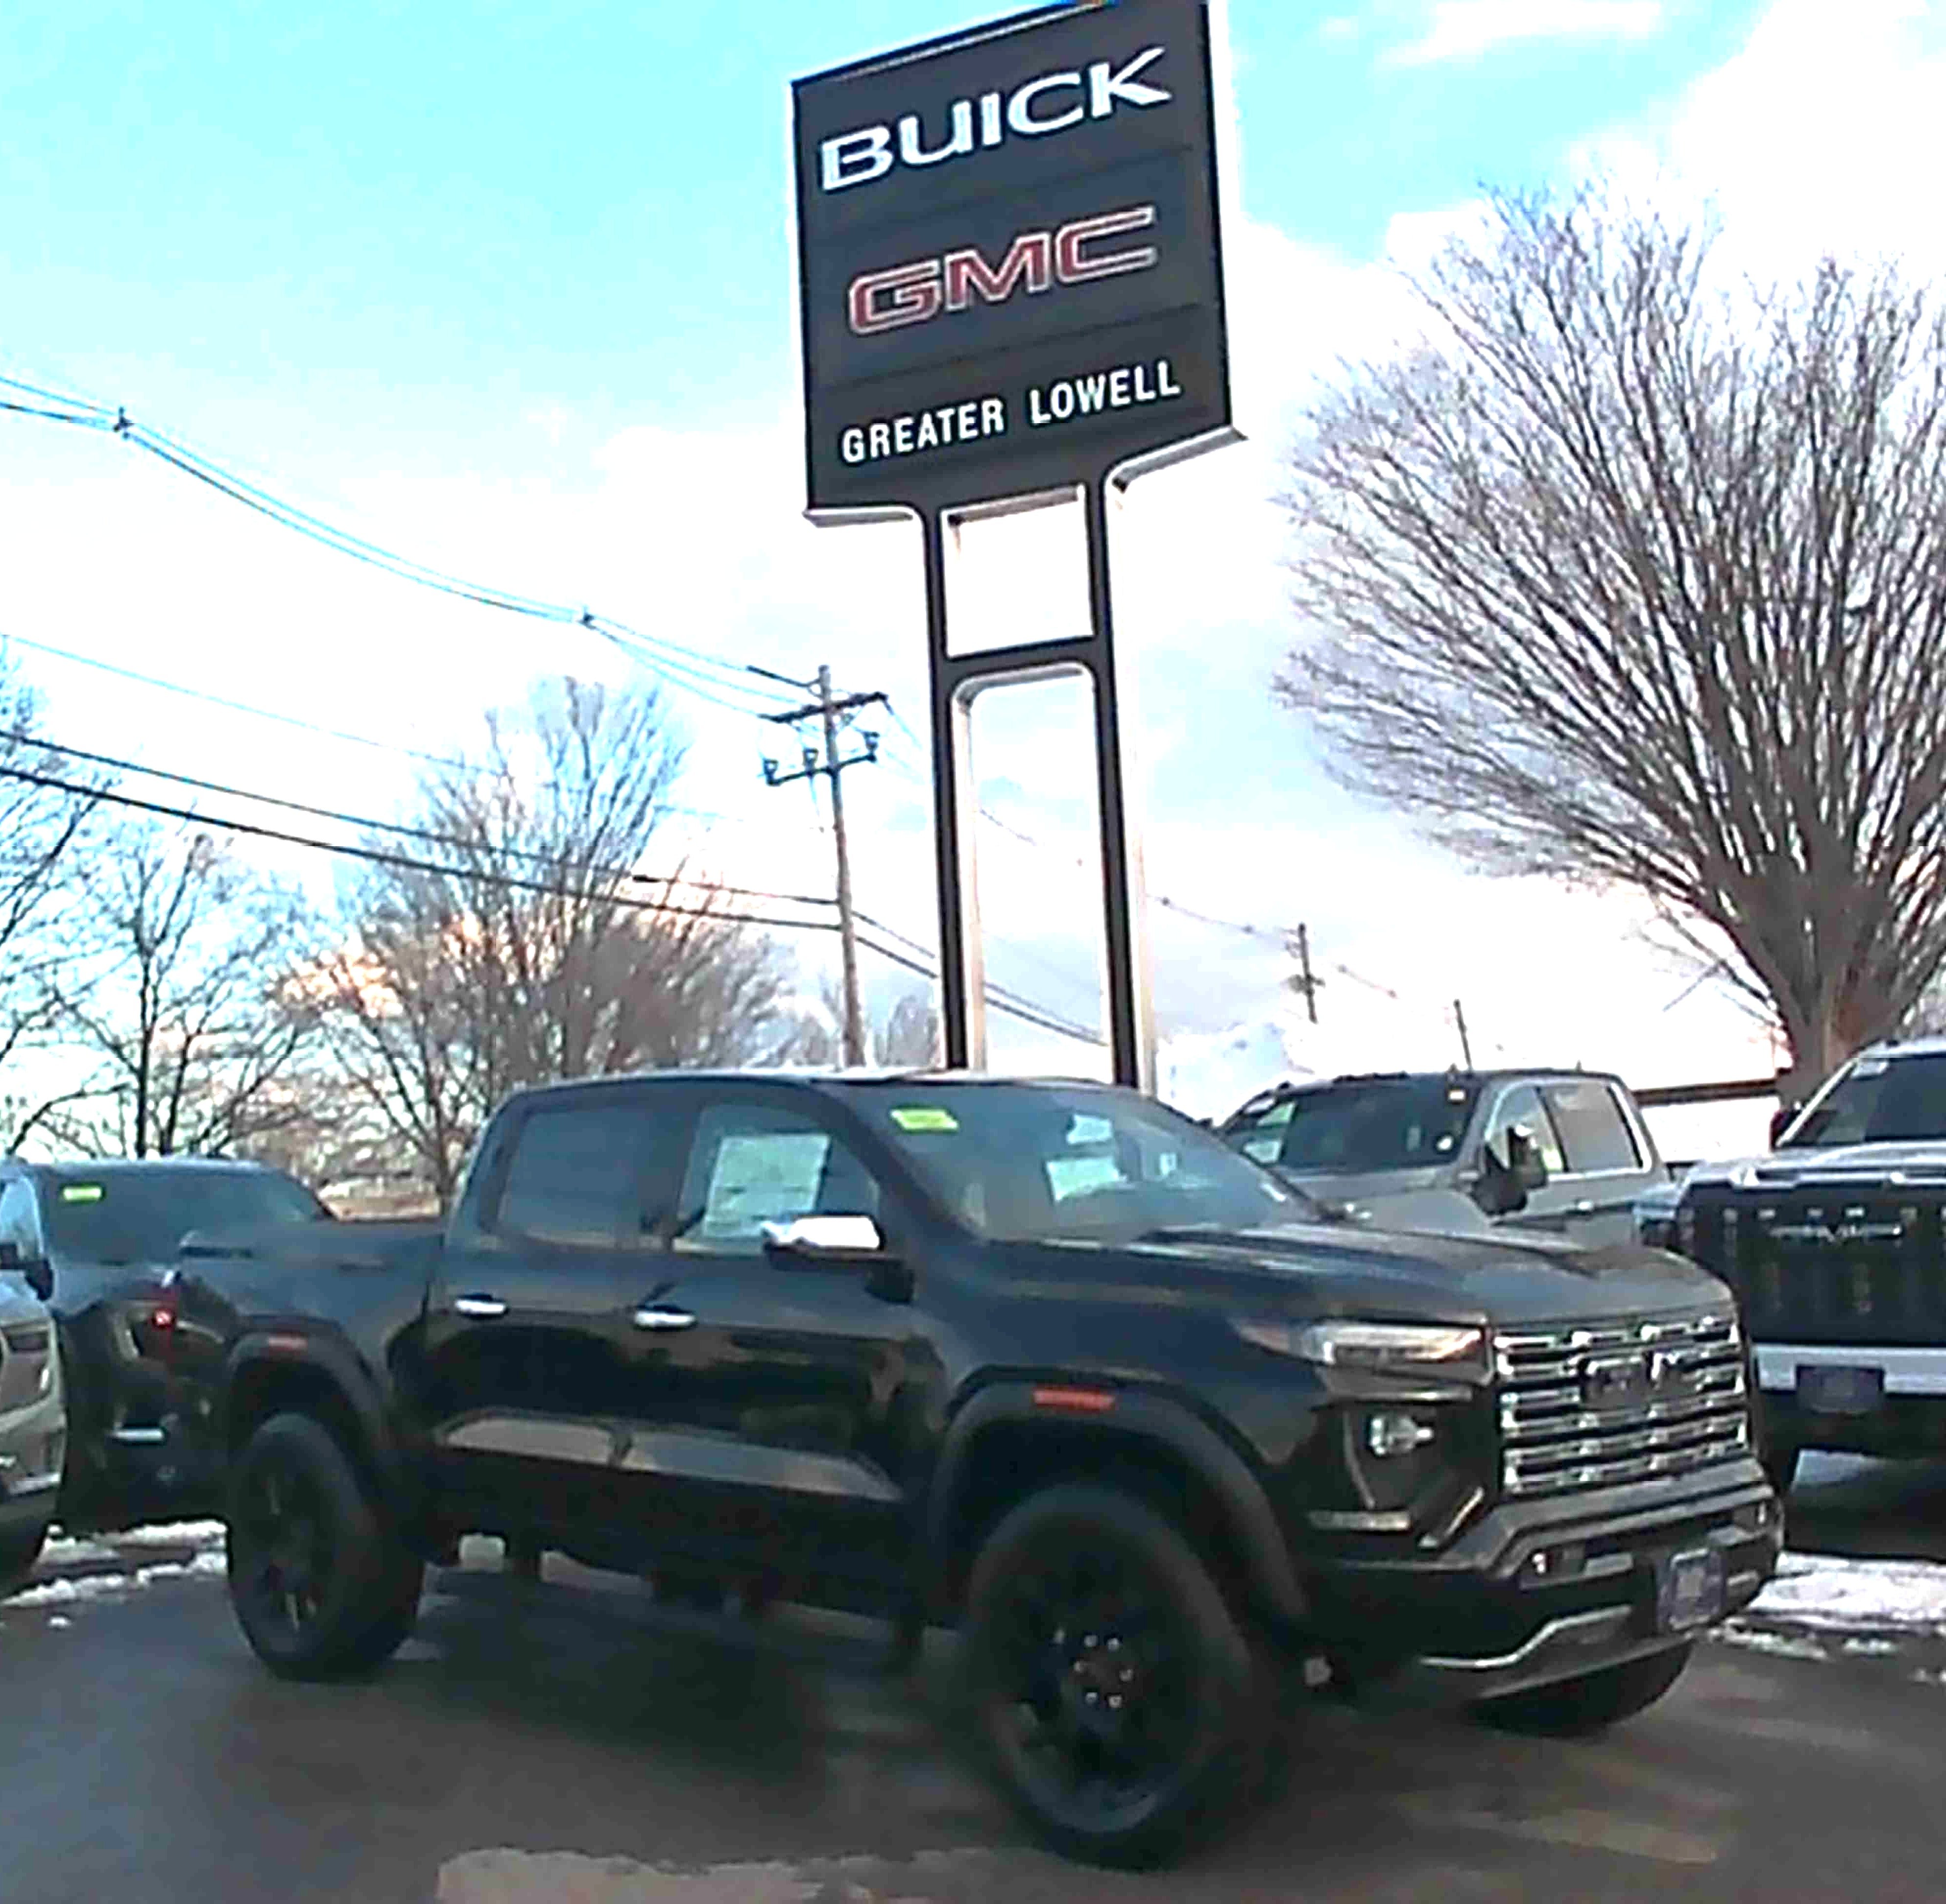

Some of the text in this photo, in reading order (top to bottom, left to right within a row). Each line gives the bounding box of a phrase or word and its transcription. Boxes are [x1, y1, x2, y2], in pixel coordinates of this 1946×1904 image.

[820, 47, 1172, 190] BUICK
[849, 206, 1157, 334] GMC
[842, 361, 1181, 463] GREATER LOWELL
